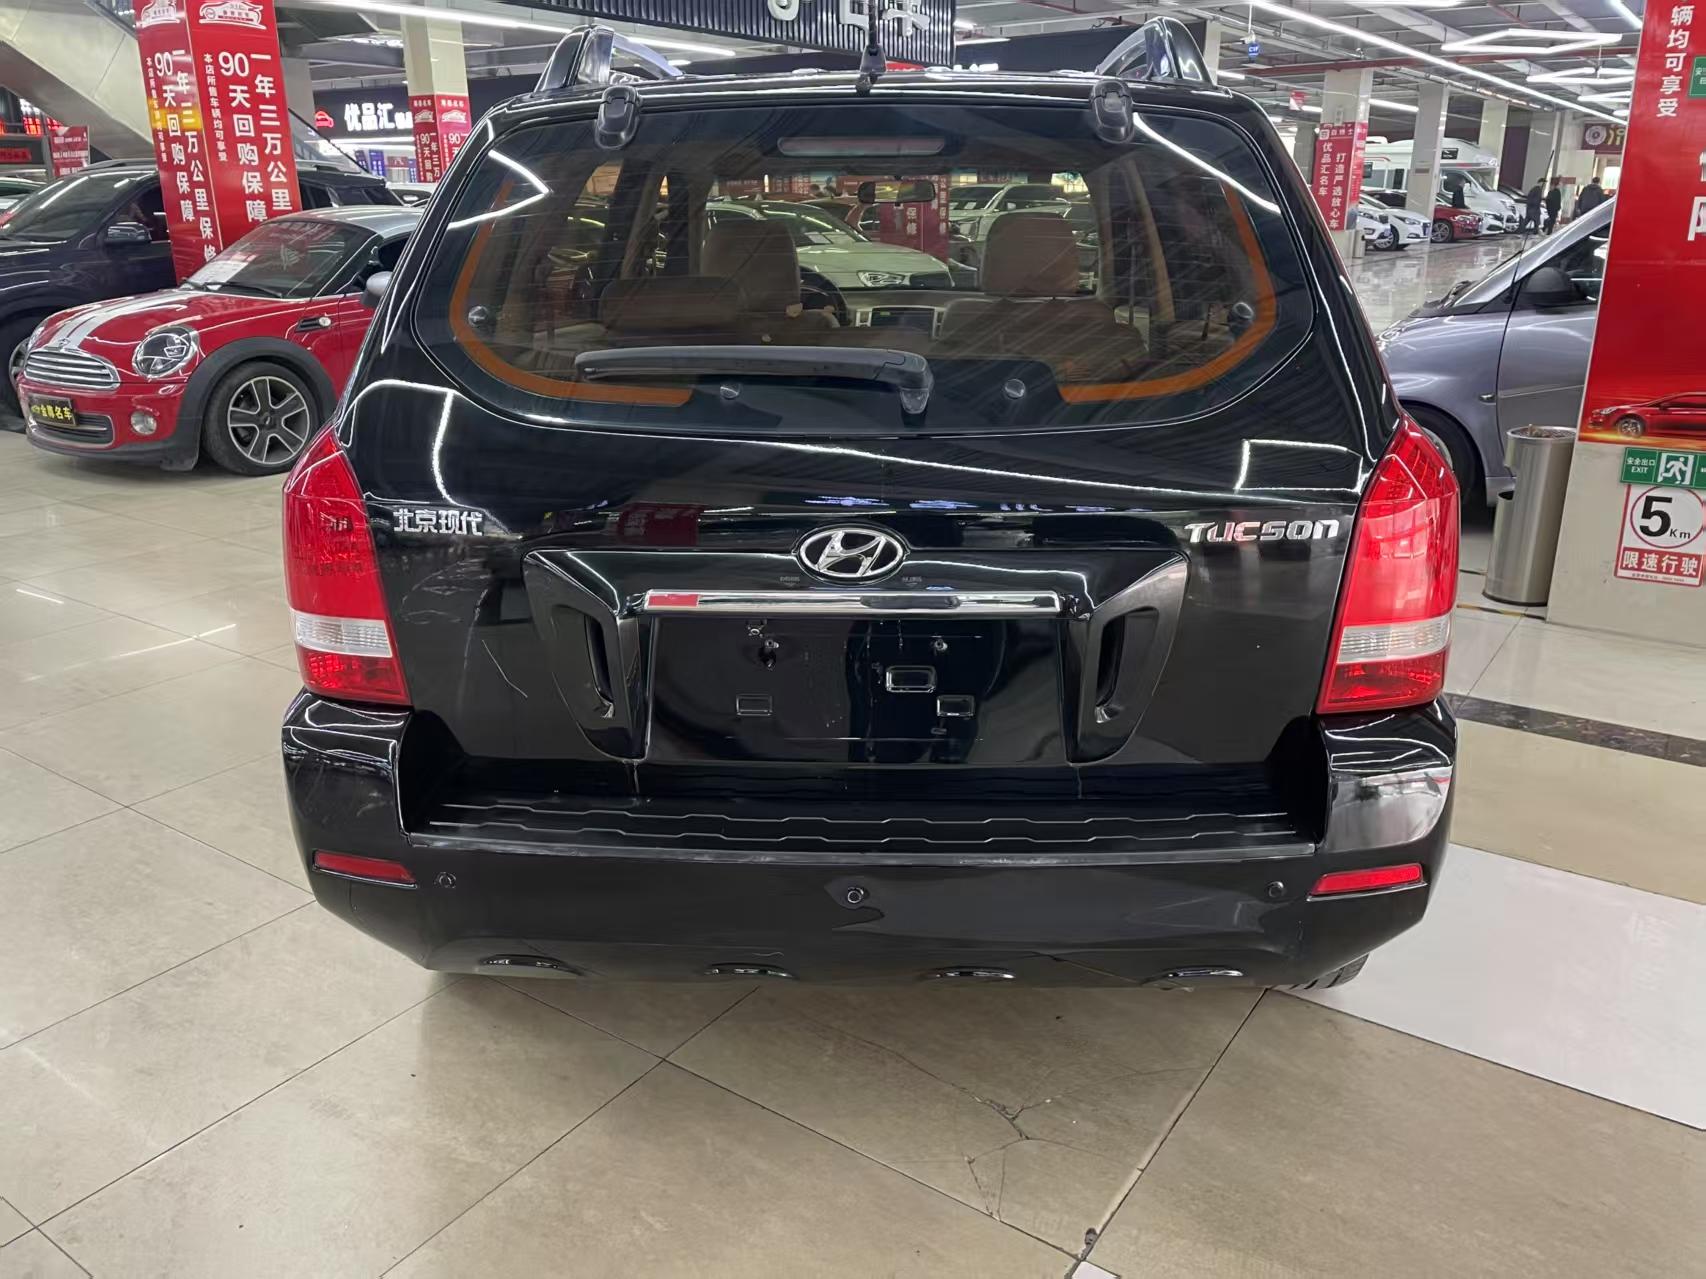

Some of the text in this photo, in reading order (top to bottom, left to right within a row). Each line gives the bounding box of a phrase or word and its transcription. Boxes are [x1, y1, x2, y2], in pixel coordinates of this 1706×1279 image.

[1656, 5, 1695, 118] 辆均可享受
[154, 52, 195, 222] 90天回购保障
[218, 51, 268, 223] 90天回购保障
[250, 53, 293, 211] 一年三万公里
[430, 132, 440, 182] 一年三万
[1318, 142, 1333, 196] 优品汇名车
[1329, 152, 1347, 229] 打造严选放心车
[1627, 457, 1656, 466] 安全出口
[1631, 466, 1649, 474] EXIT
[393, 508, 483, 536] 北京现代
[1640, 495, 1672, 537] 5
[1622, 551, 1698, 576] 限速行驶
